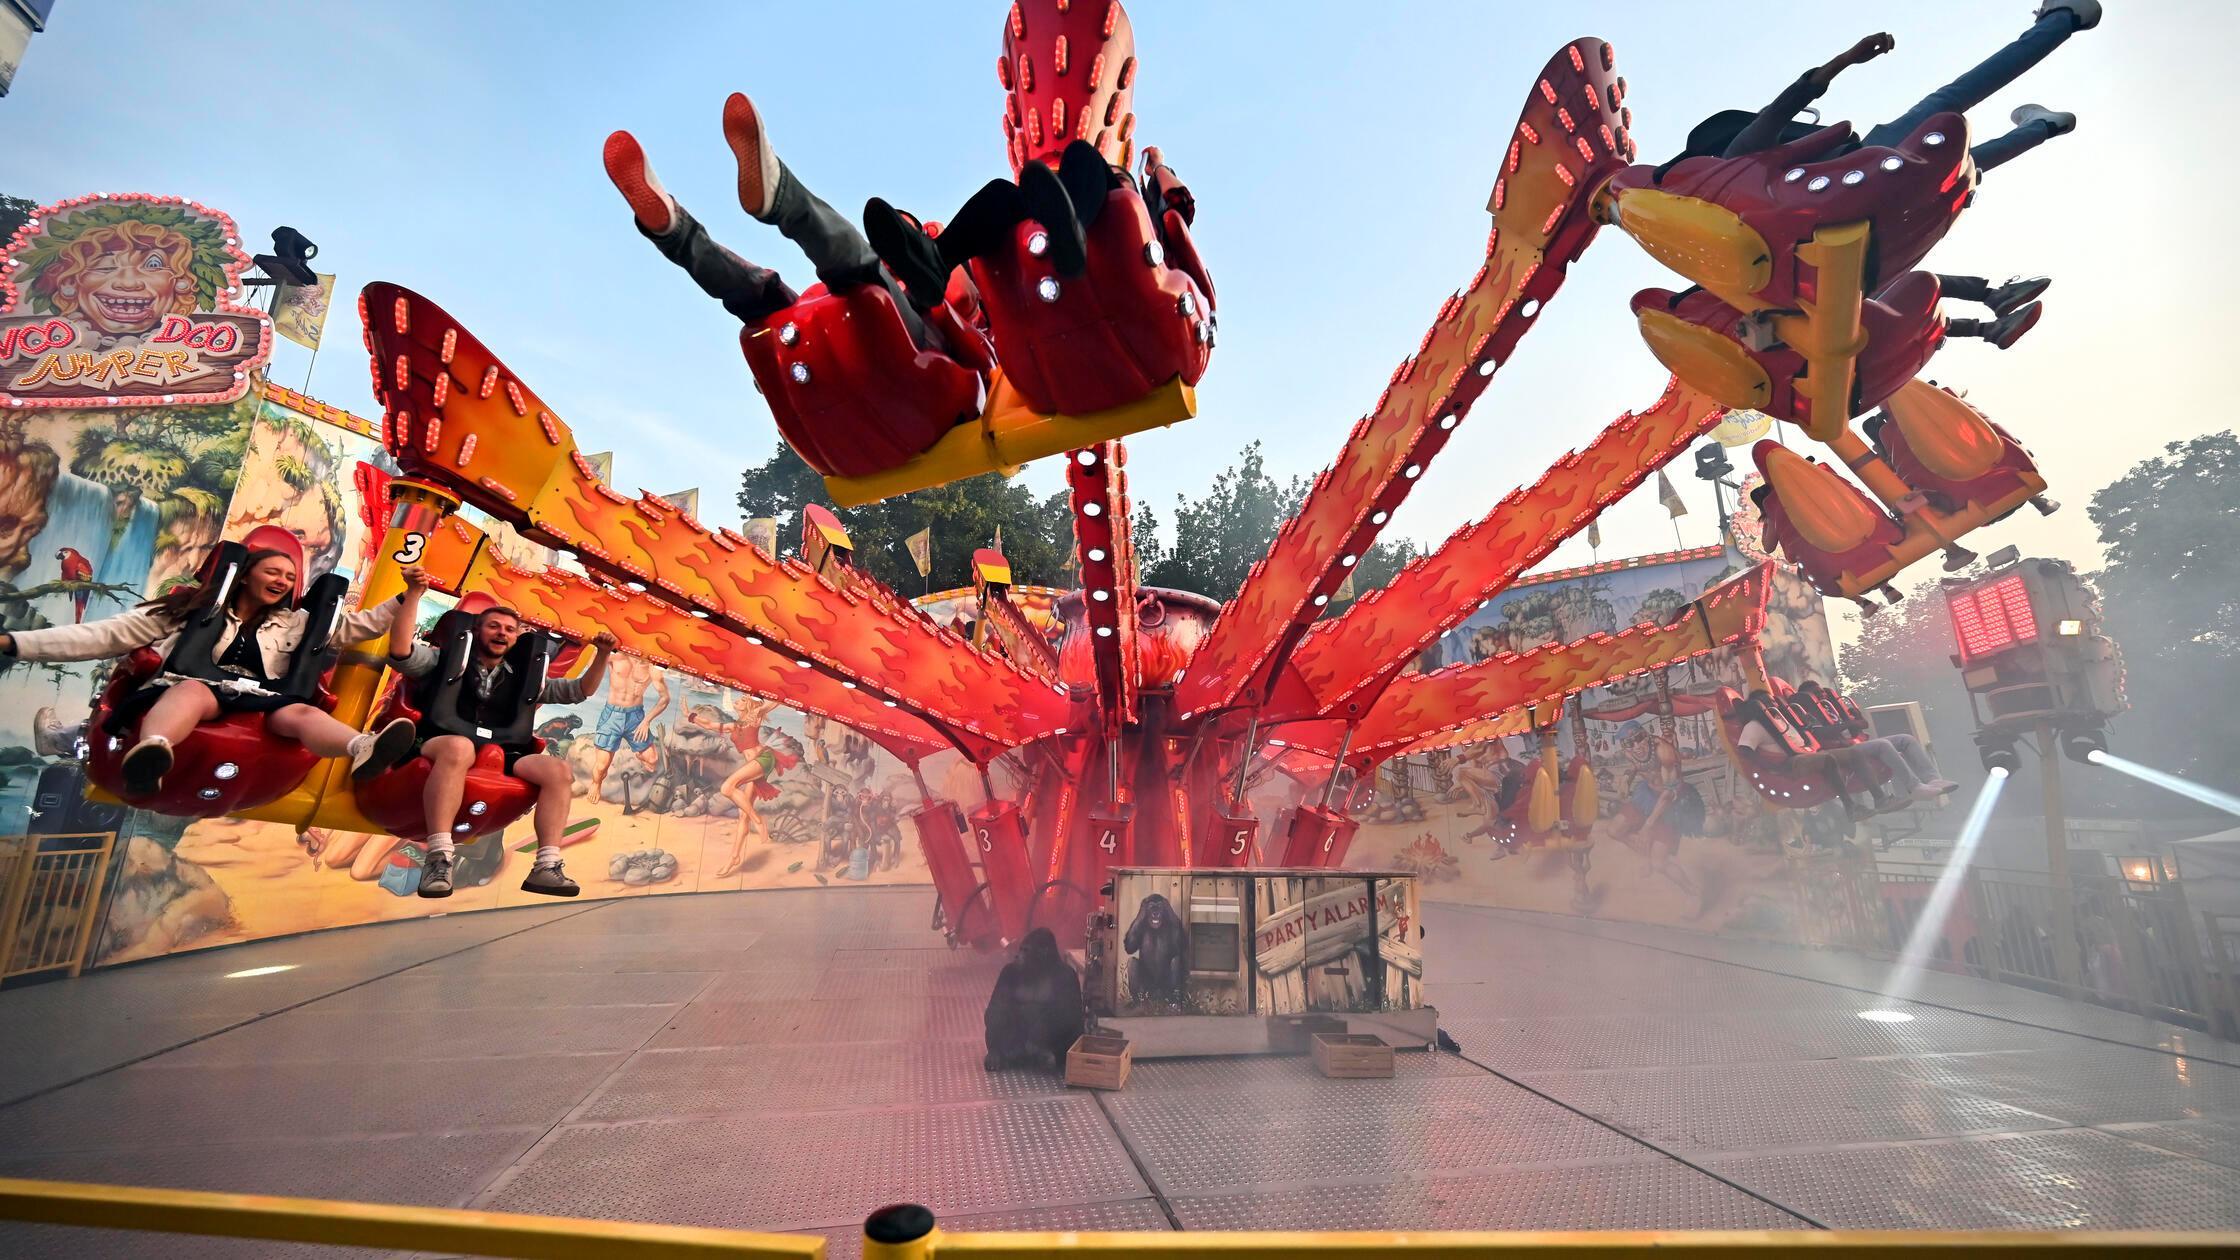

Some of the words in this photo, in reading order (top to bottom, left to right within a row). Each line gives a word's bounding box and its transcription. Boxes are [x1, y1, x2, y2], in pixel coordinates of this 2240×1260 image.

[151, 316, 238, 352] DOO
[17, 349, 200, 385] JUMPER
[392, 531, 426, 564] 3
[979, 828, 992, 852] 3
[1099, 830, 1117, 854] 4
[1230, 830, 1249, 855] 5
[1324, 829, 1336, 852] 6
[1264, 910, 1318, 947] PARTY
[1323, 894, 1390, 926] ALARM
